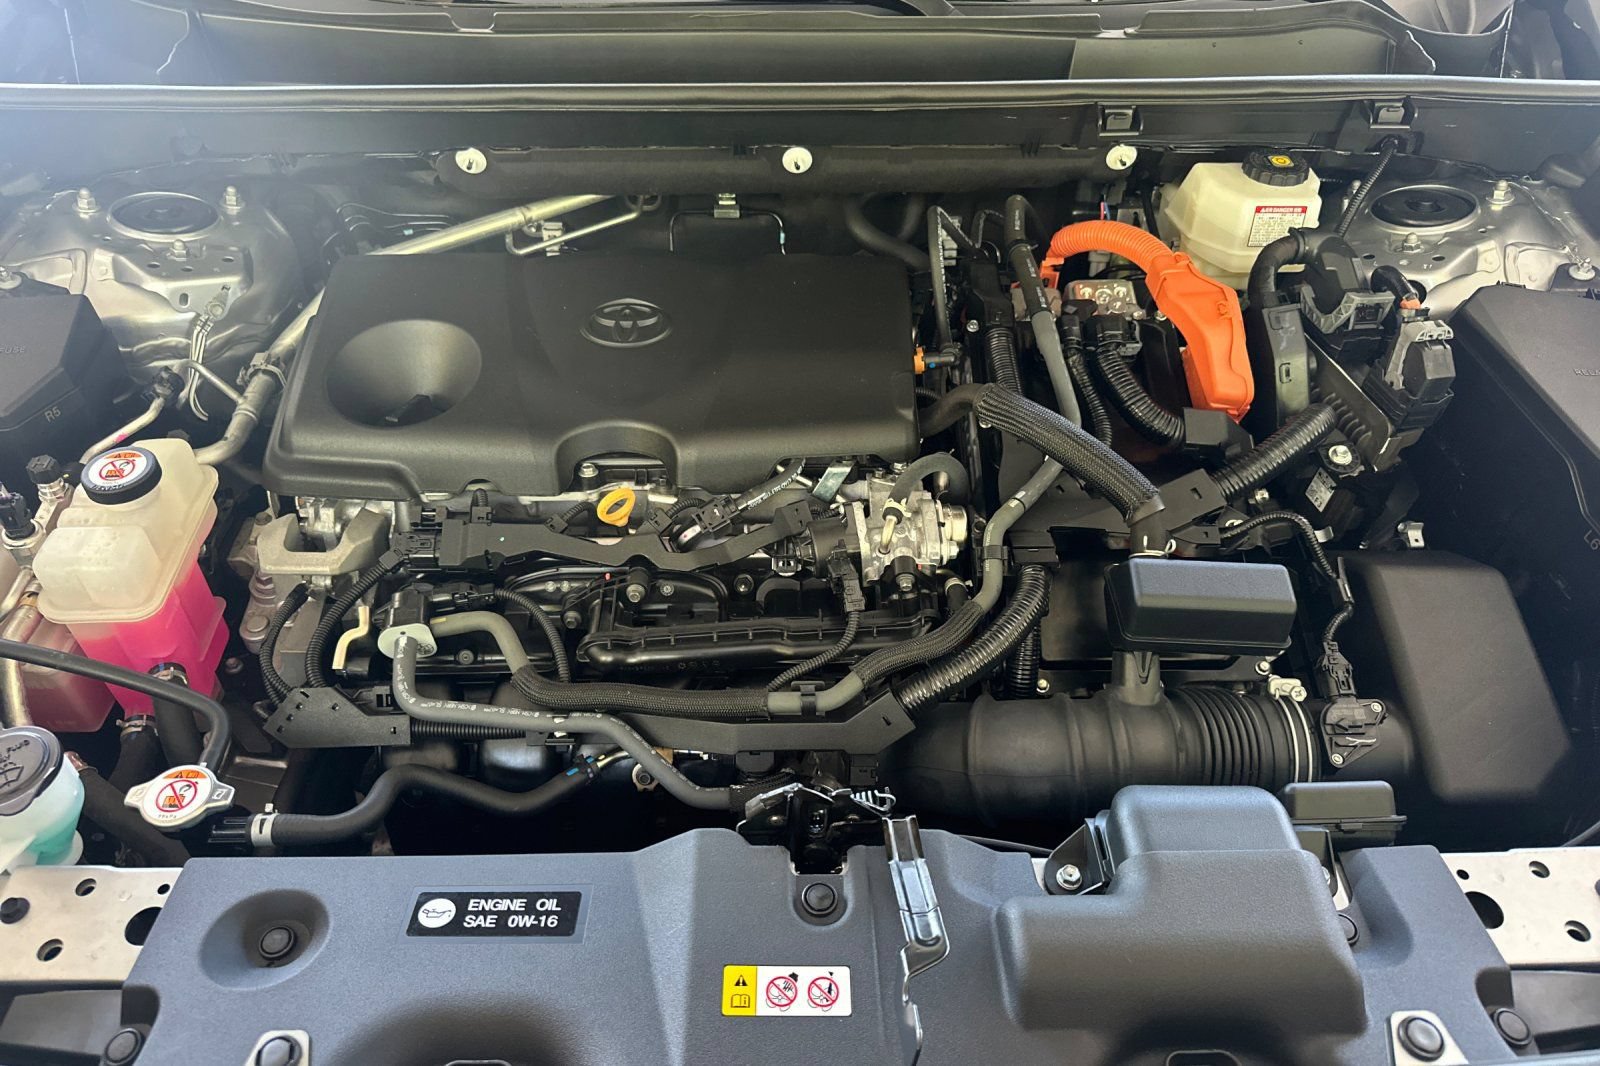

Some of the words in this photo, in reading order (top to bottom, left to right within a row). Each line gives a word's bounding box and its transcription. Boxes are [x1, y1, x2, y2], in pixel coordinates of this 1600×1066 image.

[44, 406, 61, 422] R5
[467, 898, 527, 911] ENGINE
[536, 898, 562, 911] OIL
[463, 915, 498, 928] SAE
[507, 915, 559, 928] 0W-16
